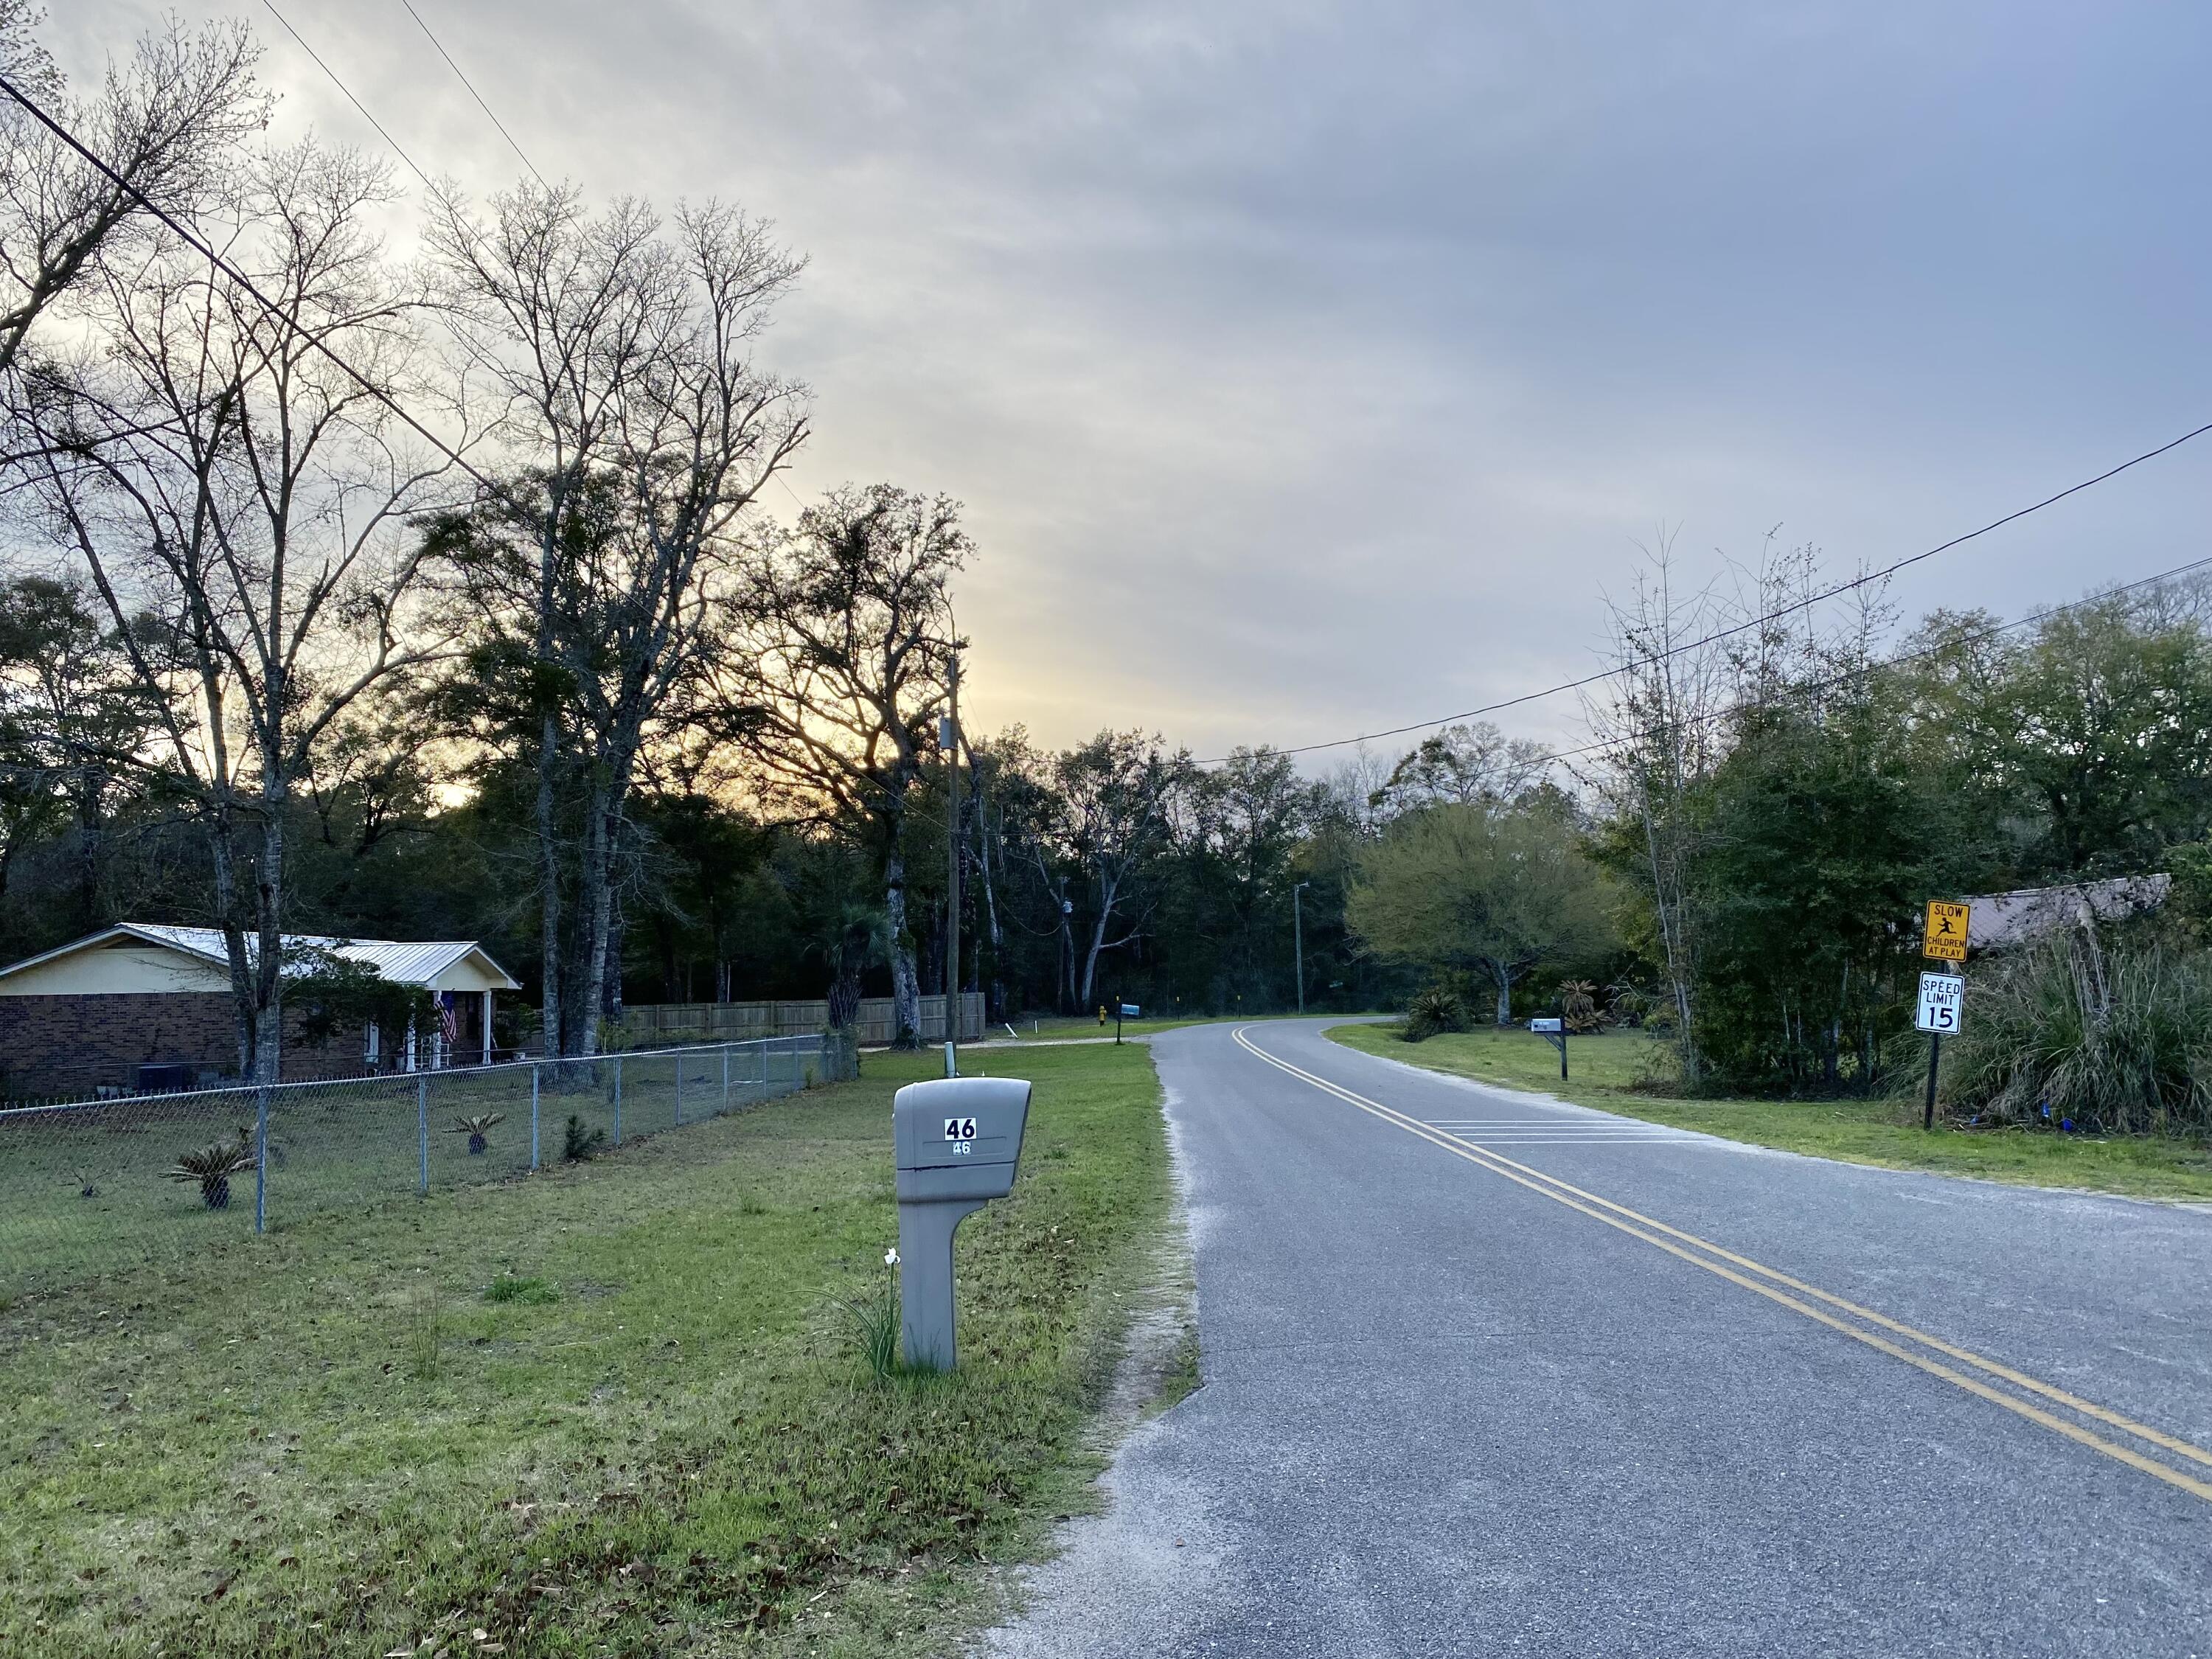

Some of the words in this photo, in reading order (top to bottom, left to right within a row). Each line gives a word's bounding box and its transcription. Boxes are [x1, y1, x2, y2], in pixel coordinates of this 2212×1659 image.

[1934, 905, 1963, 917] SLOW
[1927, 936, 1964, 947] CHILDREN
[1929, 946, 1938, 954] AT
[1941, 947, 1961, 958] PLAY
[1923, 981, 1960, 994] SPEED
[1927, 992, 1954, 1005] LIMIT
[1930, 1006, 1953, 1028] 15
[946, 1119, 975, 1138] 46
[953, 1141, 970, 1155] 46
